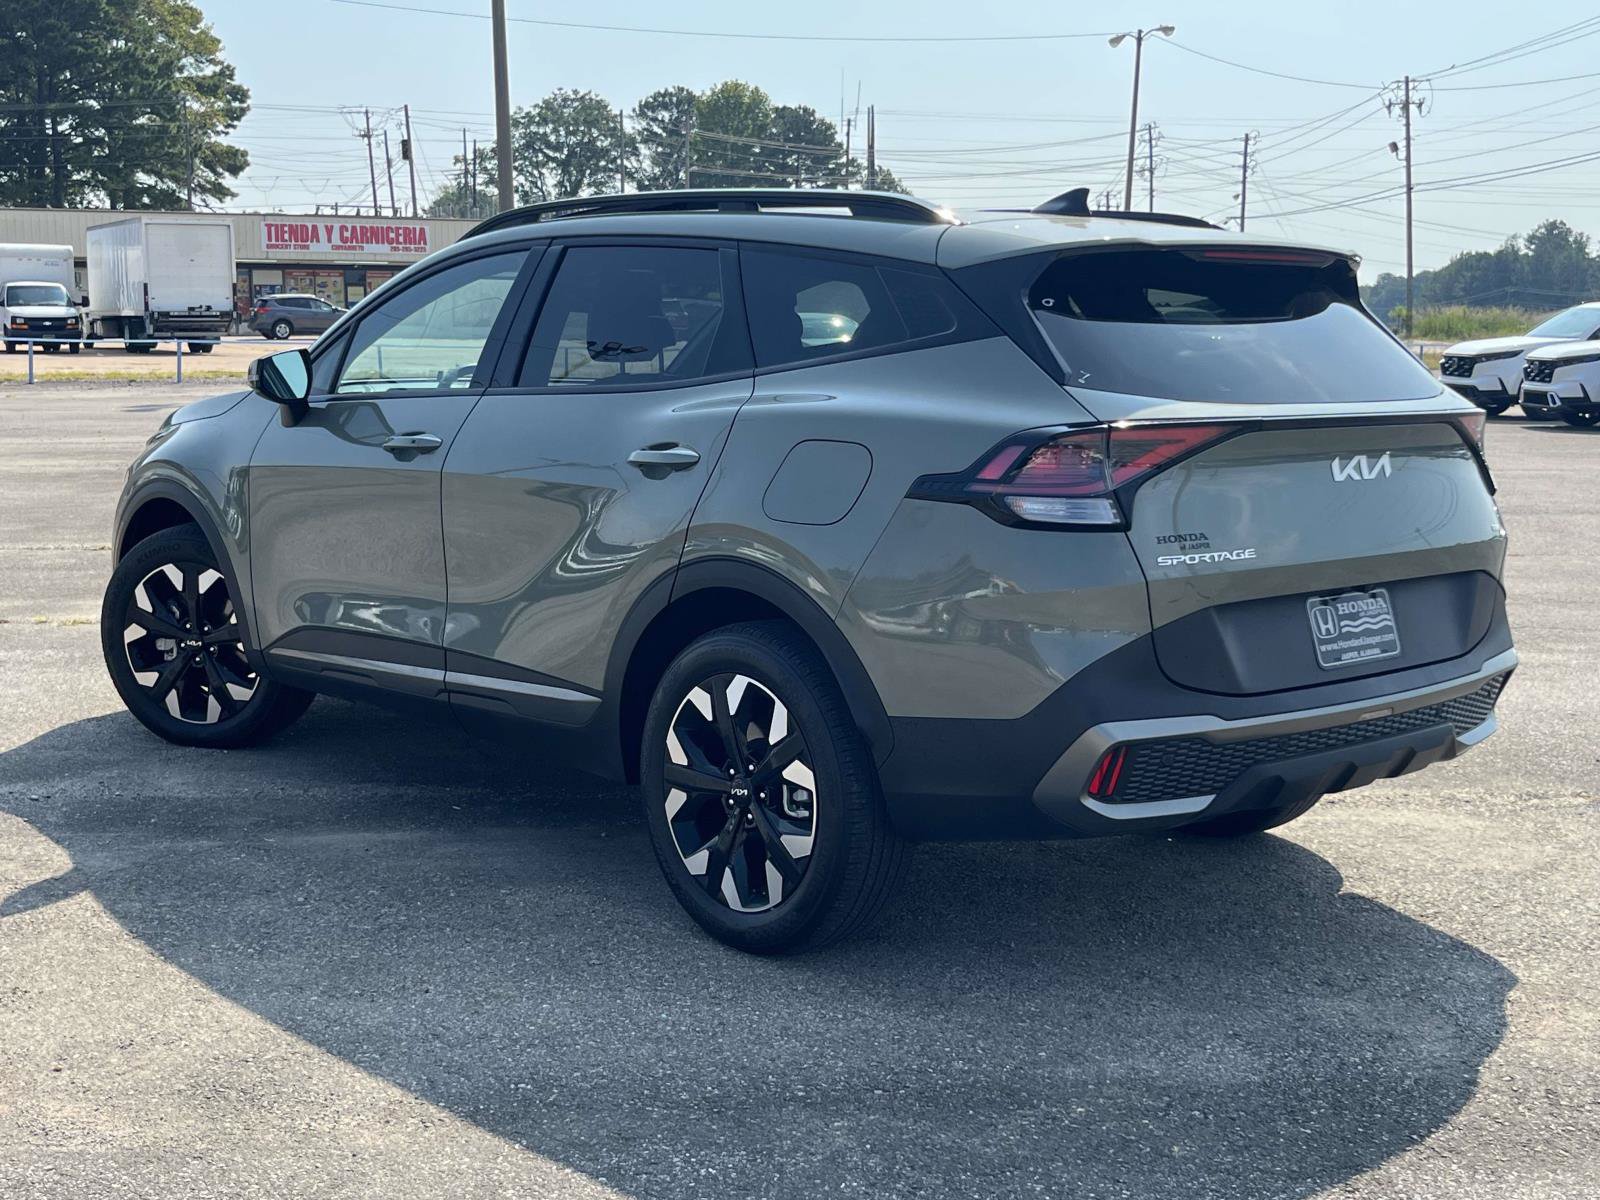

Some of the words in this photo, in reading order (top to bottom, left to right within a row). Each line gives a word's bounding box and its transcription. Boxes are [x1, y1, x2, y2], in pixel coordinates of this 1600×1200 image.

[265, 223, 320, 243] TIENDA
[324, 224, 334, 243] Y
[339, 224, 427, 245] CARNICERIA
[1331, 453, 1392, 482] KIA
[1155, 532, 1209, 545] HONDA
[1157, 548, 1257, 566] SPORTAGE
[1336, 597, 1387, 615] HONDA
